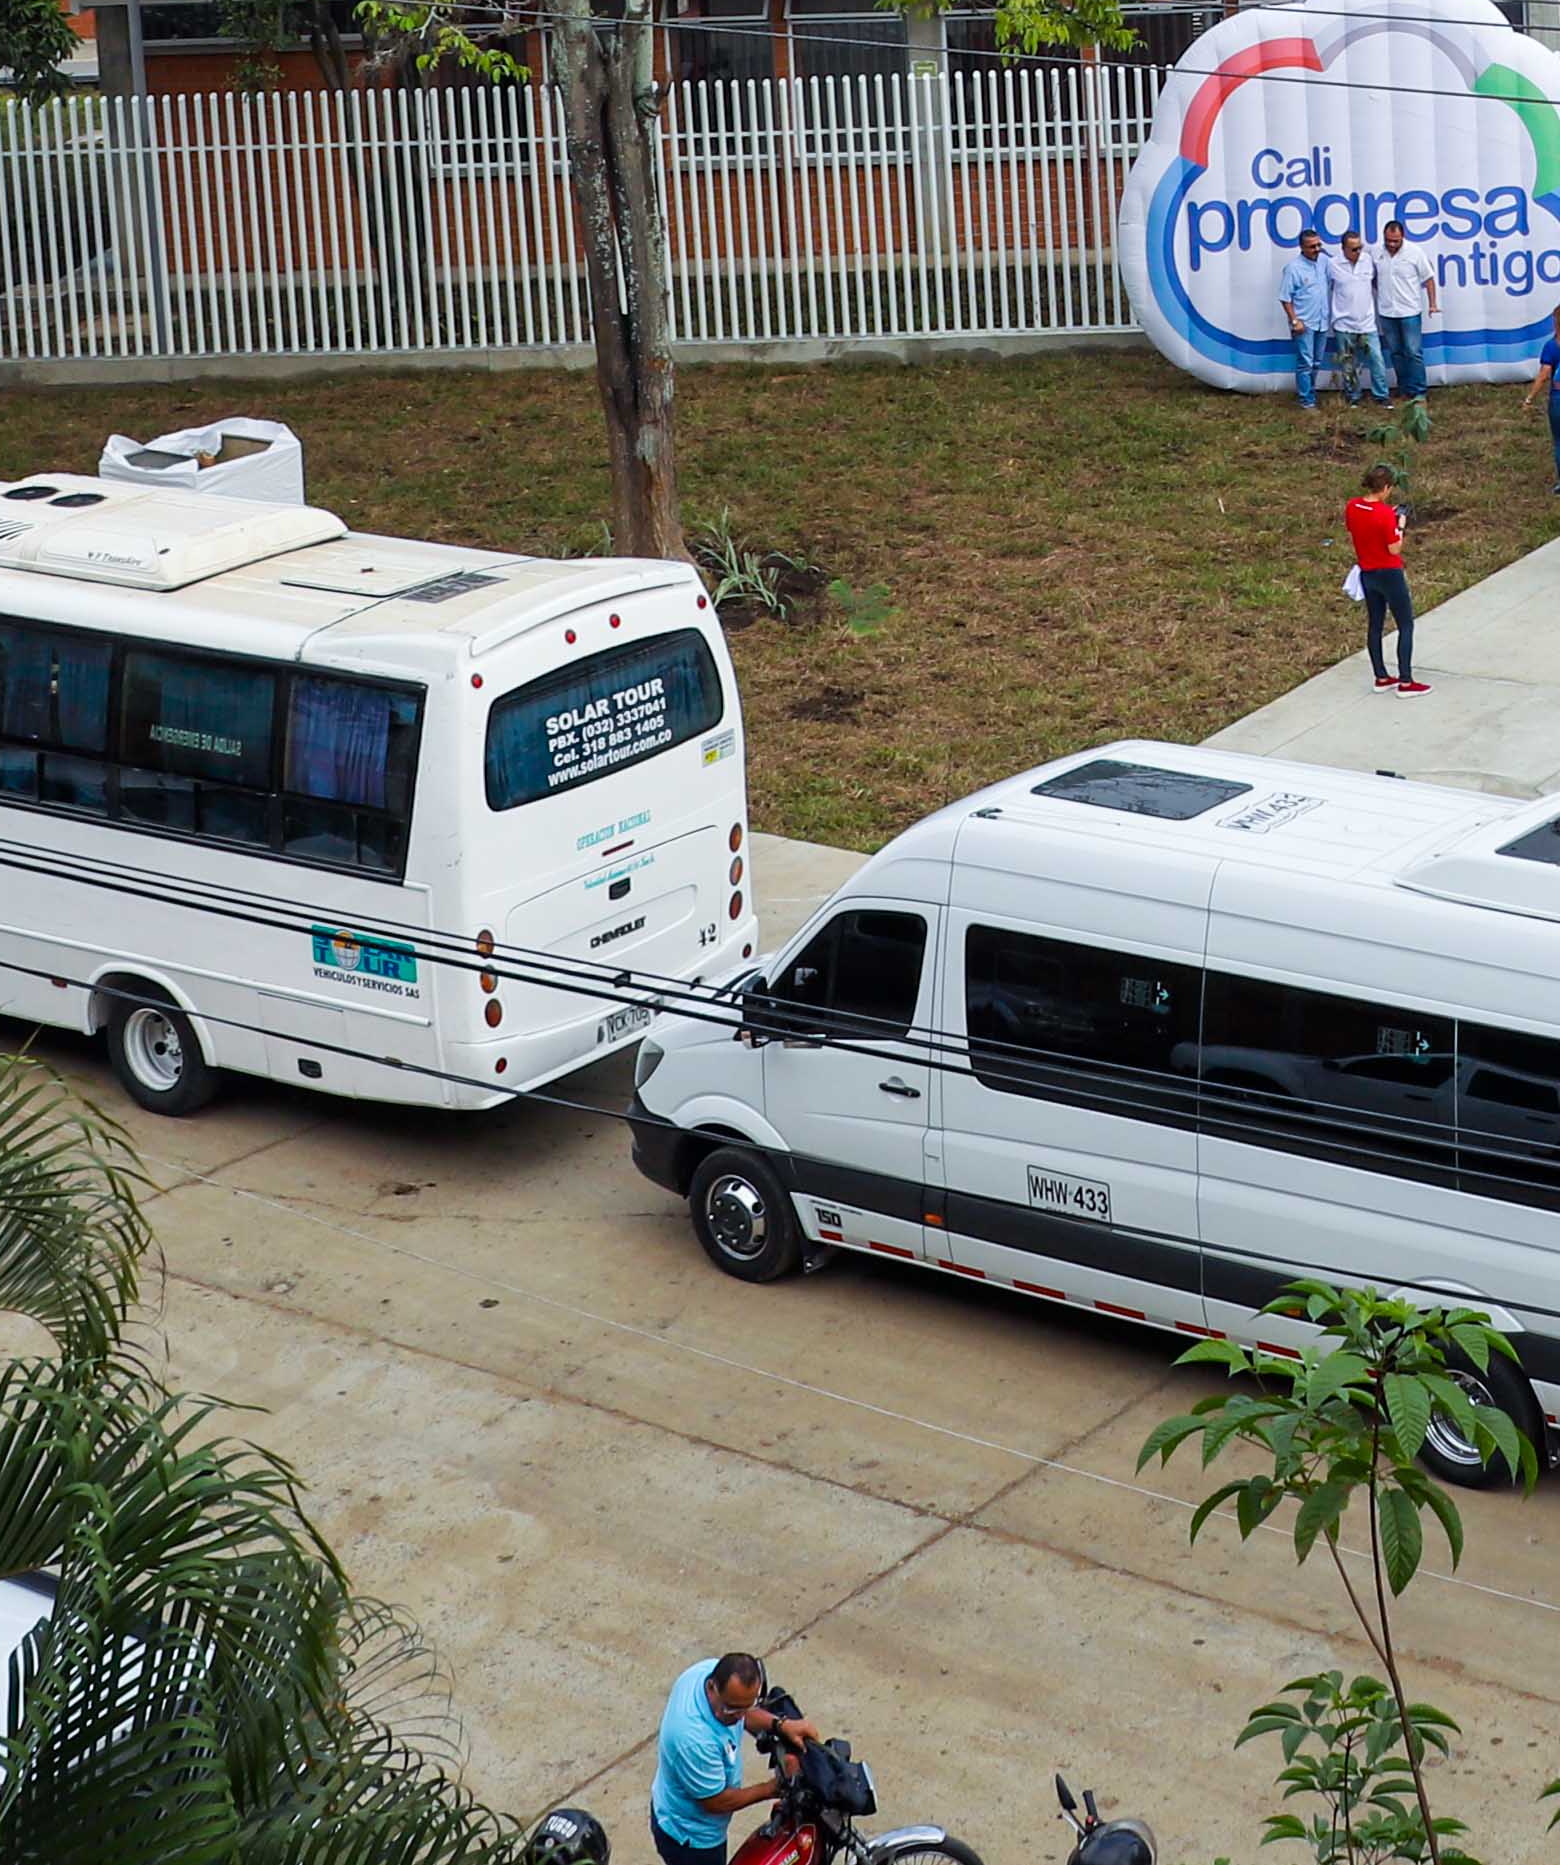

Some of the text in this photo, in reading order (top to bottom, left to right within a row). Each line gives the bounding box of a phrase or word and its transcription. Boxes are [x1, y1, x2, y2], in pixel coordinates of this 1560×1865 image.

[1251, 146, 1332, 190] Cali
[1187, 185, 1530, 272] progresa
[546, 678, 665, 736] SOLAR TOUR
[548, 697, 667, 753] PBX. (032) 3337041
[547, 728, 673, 787] www.solartour.com.co
[553, 714, 665, 767] Cel. 318 883 1405
[590, 915, 647, 949] CHEVROLET
